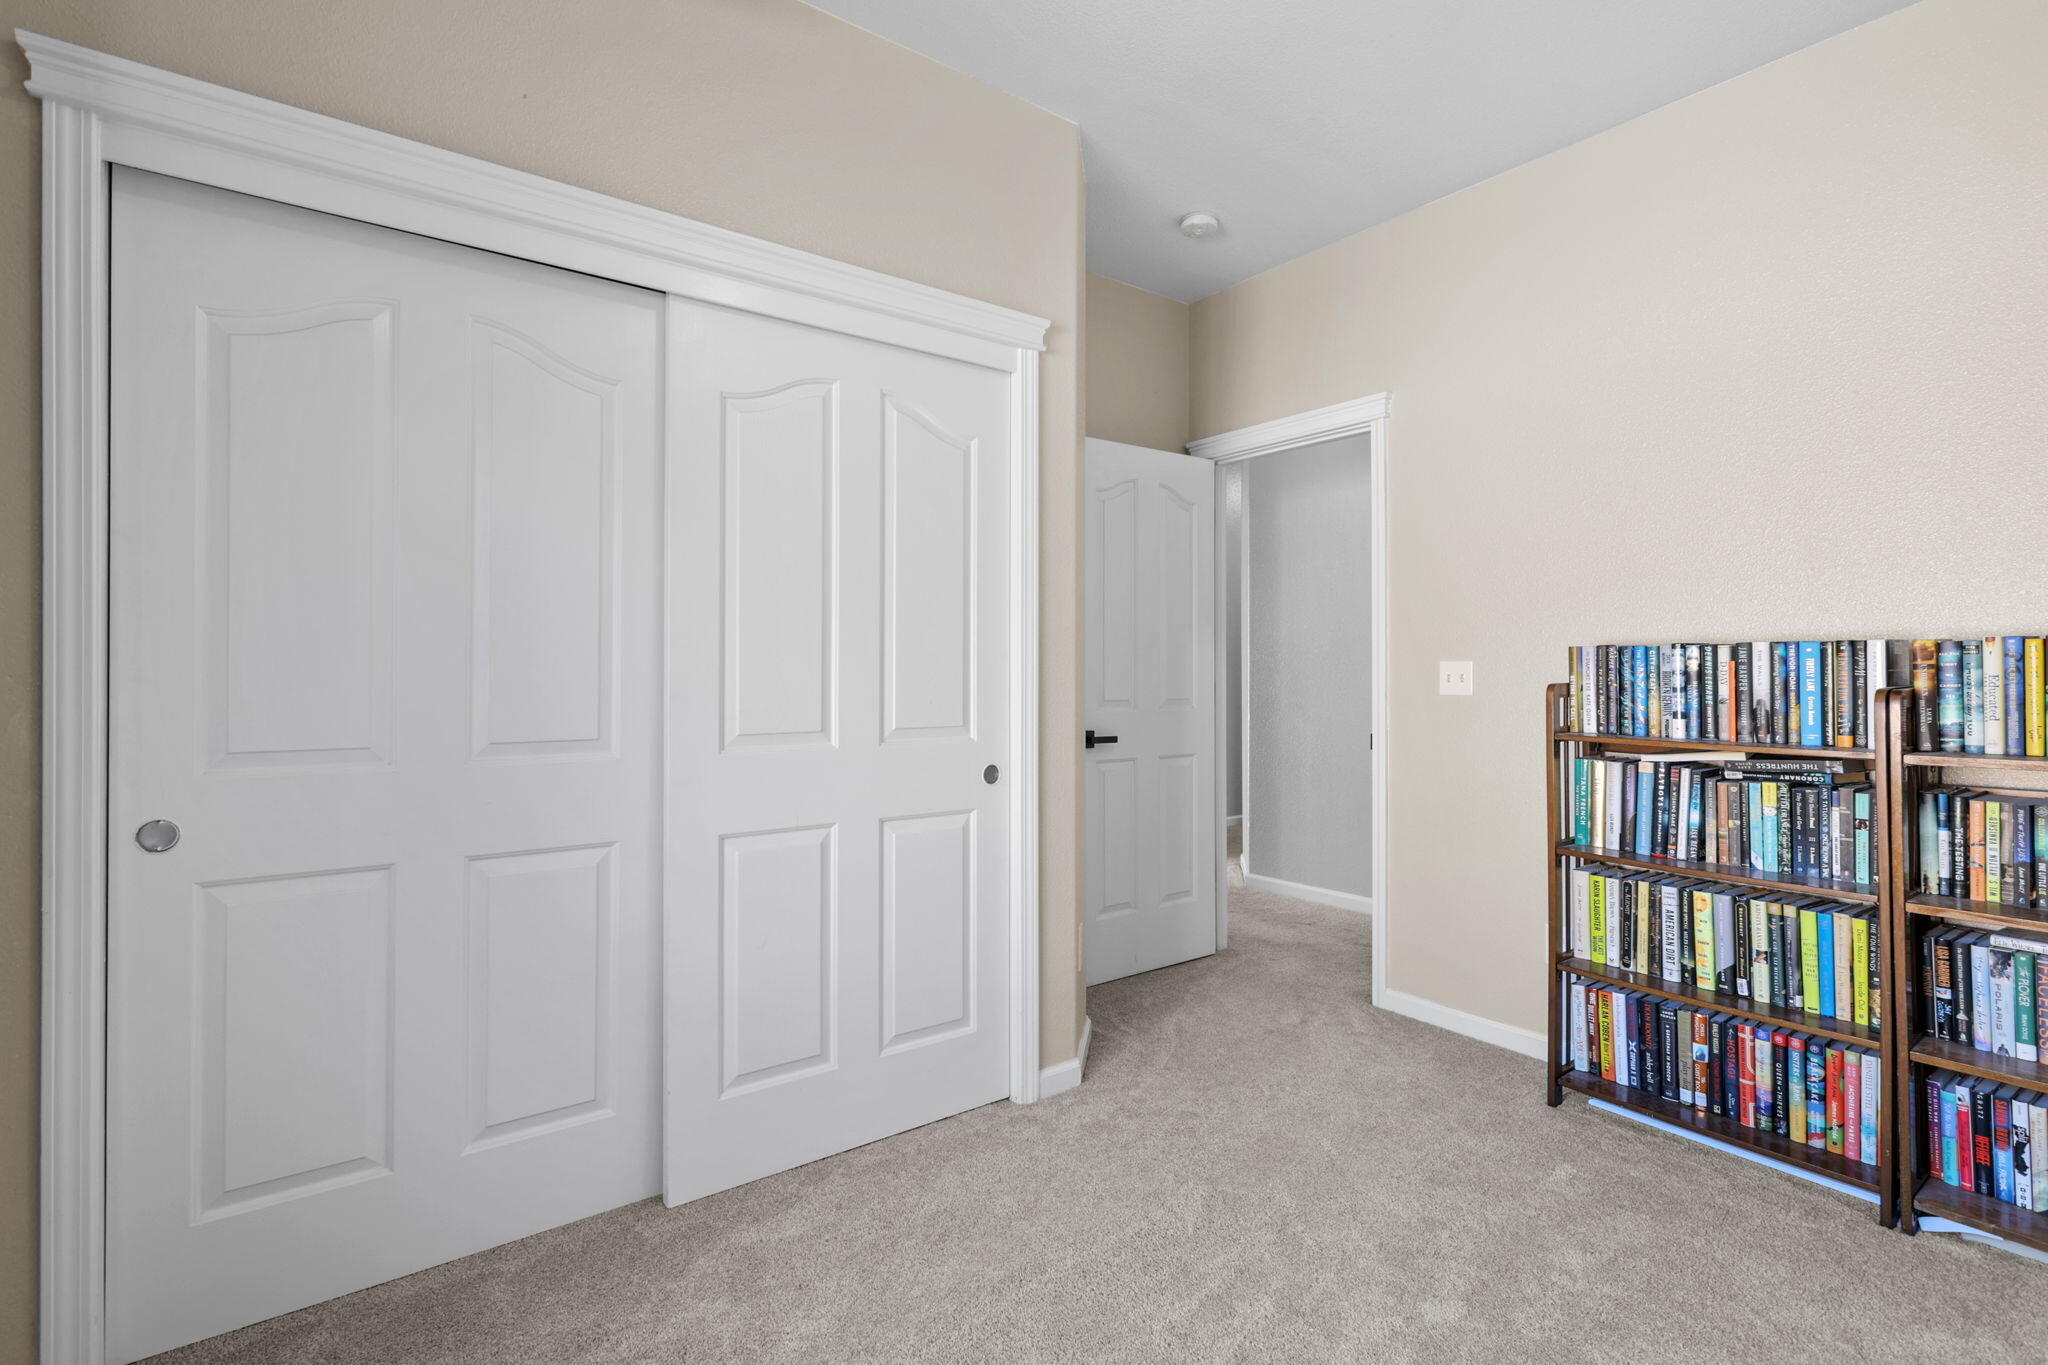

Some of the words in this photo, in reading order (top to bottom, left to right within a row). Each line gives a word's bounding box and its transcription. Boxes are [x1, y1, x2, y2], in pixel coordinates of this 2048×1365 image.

[1704, 646, 1713, 674] DENNIS
[1738, 646, 1747, 662] JANE
[1738, 666, 1748, 692] HARPER
[1806, 658, 1815, 678] FIREFLY
[1920, 664, 1928, 696] UNBROKEN
[1662, 670, 1672, 694] BROKEN
[1806, 678, 1815, 692] LANE
[1662, 695, 1672, 717] GENIUS
[1988, 674, 2000, 720] Educated
[1690, 840, 1698, 858] REGAN
[1955, 828, 1964, 845] THE
[1955, 848, 1964, 882] TESTING
[1665, 908, 1674, 946] AMERICAN
[1666, 948, 1675, 964] DIRT
[1936, 946, 1949, 958] LISA
[1936, 960, 1950, 987] GARDNER
[2019, 978, 2030, 1006] PLOVER
[2038, 965, 2048, 1049] FACELESS
[1727, 1040, 1736, 1080] HOSTAGE
[1792, 1050, 1800, 1076] SISTERS
[1810, 1057, 1818, 1081] BLACK
[1865, 1060, 1873, 1090] DANIELLE
[1810, 1082, 1819, 1104] CAKE
[1994, 1100, 2009, 1126] SANDRA
[1996, 1127, 2010, 1151] BROWN
[2016, 1127, 2027, 1143] split
[1975, 1134, 1990, 1166] REFUGEE
